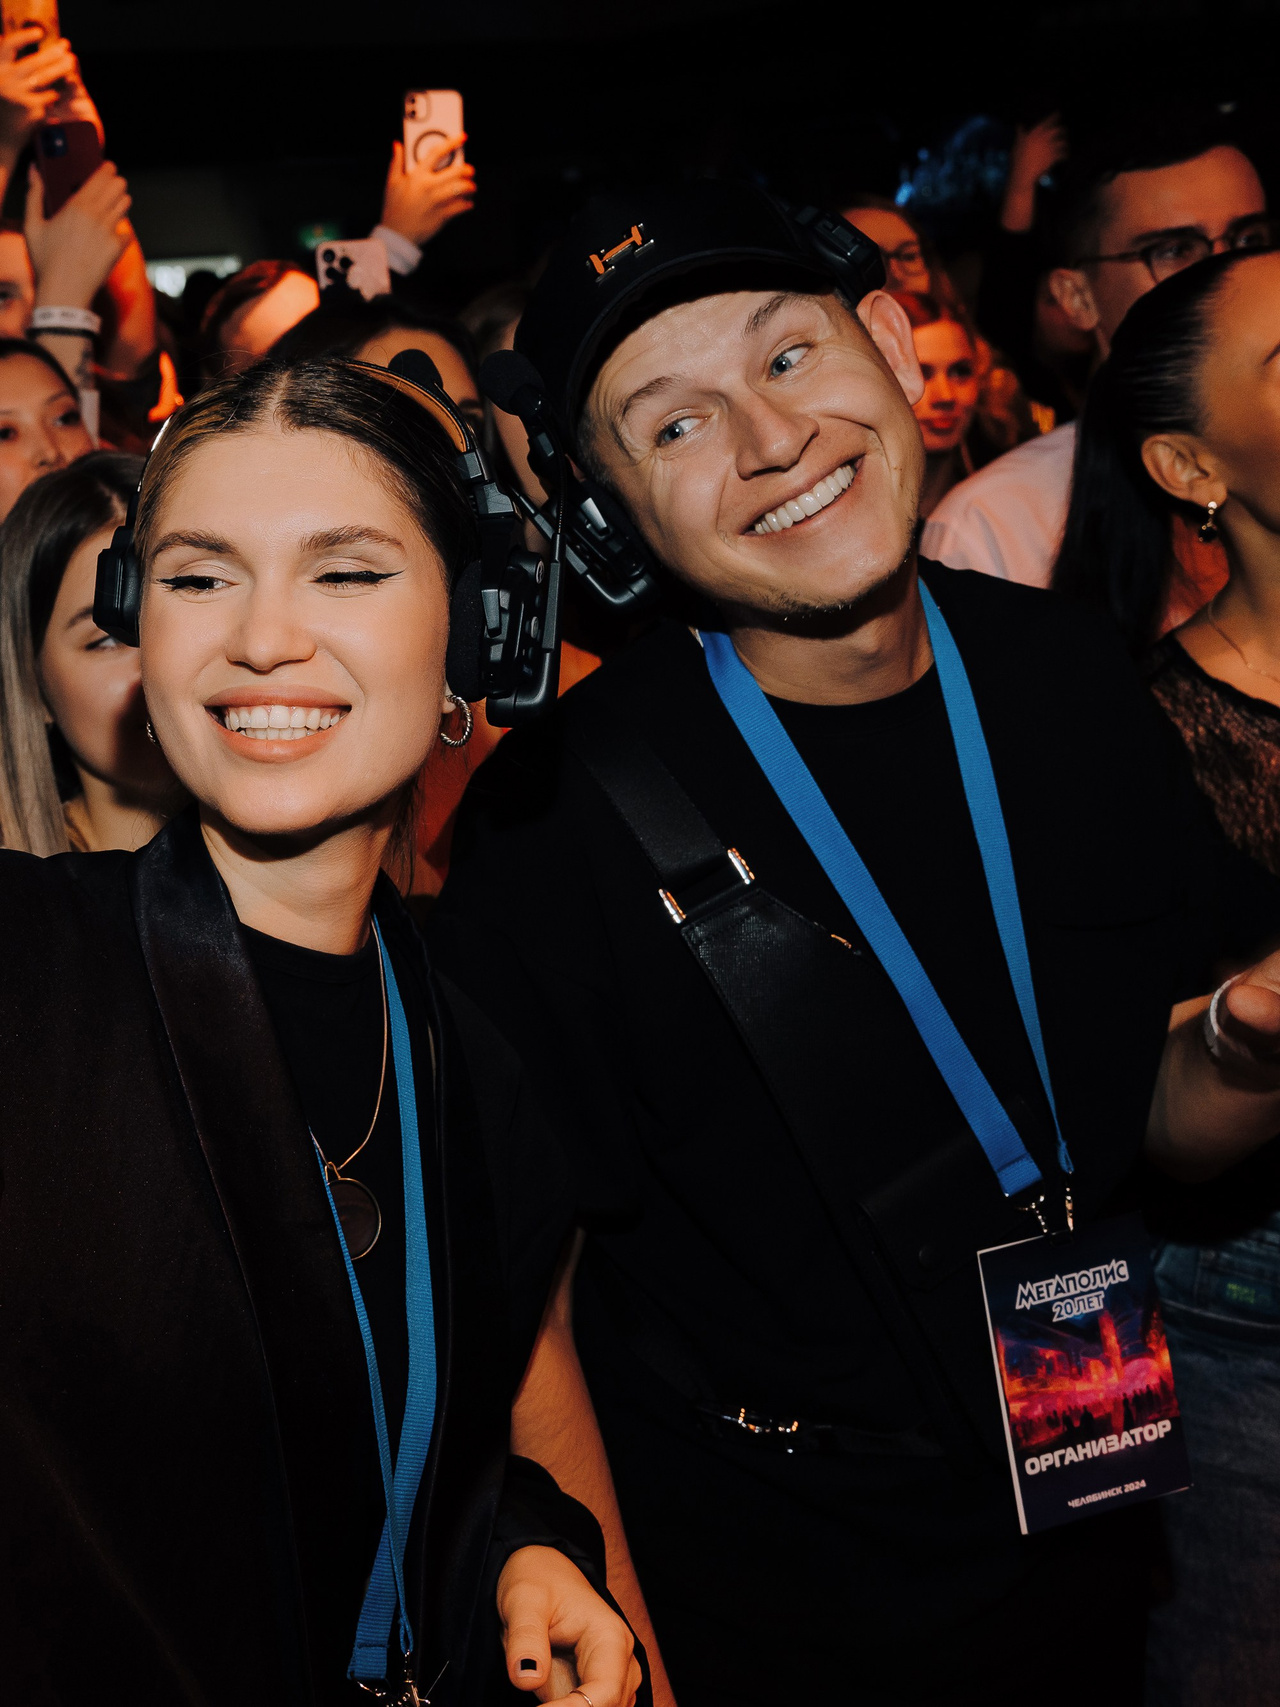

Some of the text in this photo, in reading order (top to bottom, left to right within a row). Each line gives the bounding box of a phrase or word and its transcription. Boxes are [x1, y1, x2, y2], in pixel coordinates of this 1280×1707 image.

[1015, 1259, 1130, 1311] МЕГАПОЛИС
[1052, 1290, 1105, 1322] 20 ЛЕТ
[1024, 1419, 1172, 1476] ОРГАНИЗАТОР
[1067, 1479, 1147, 1508] ЧЕЛЯБИНСК 2024
